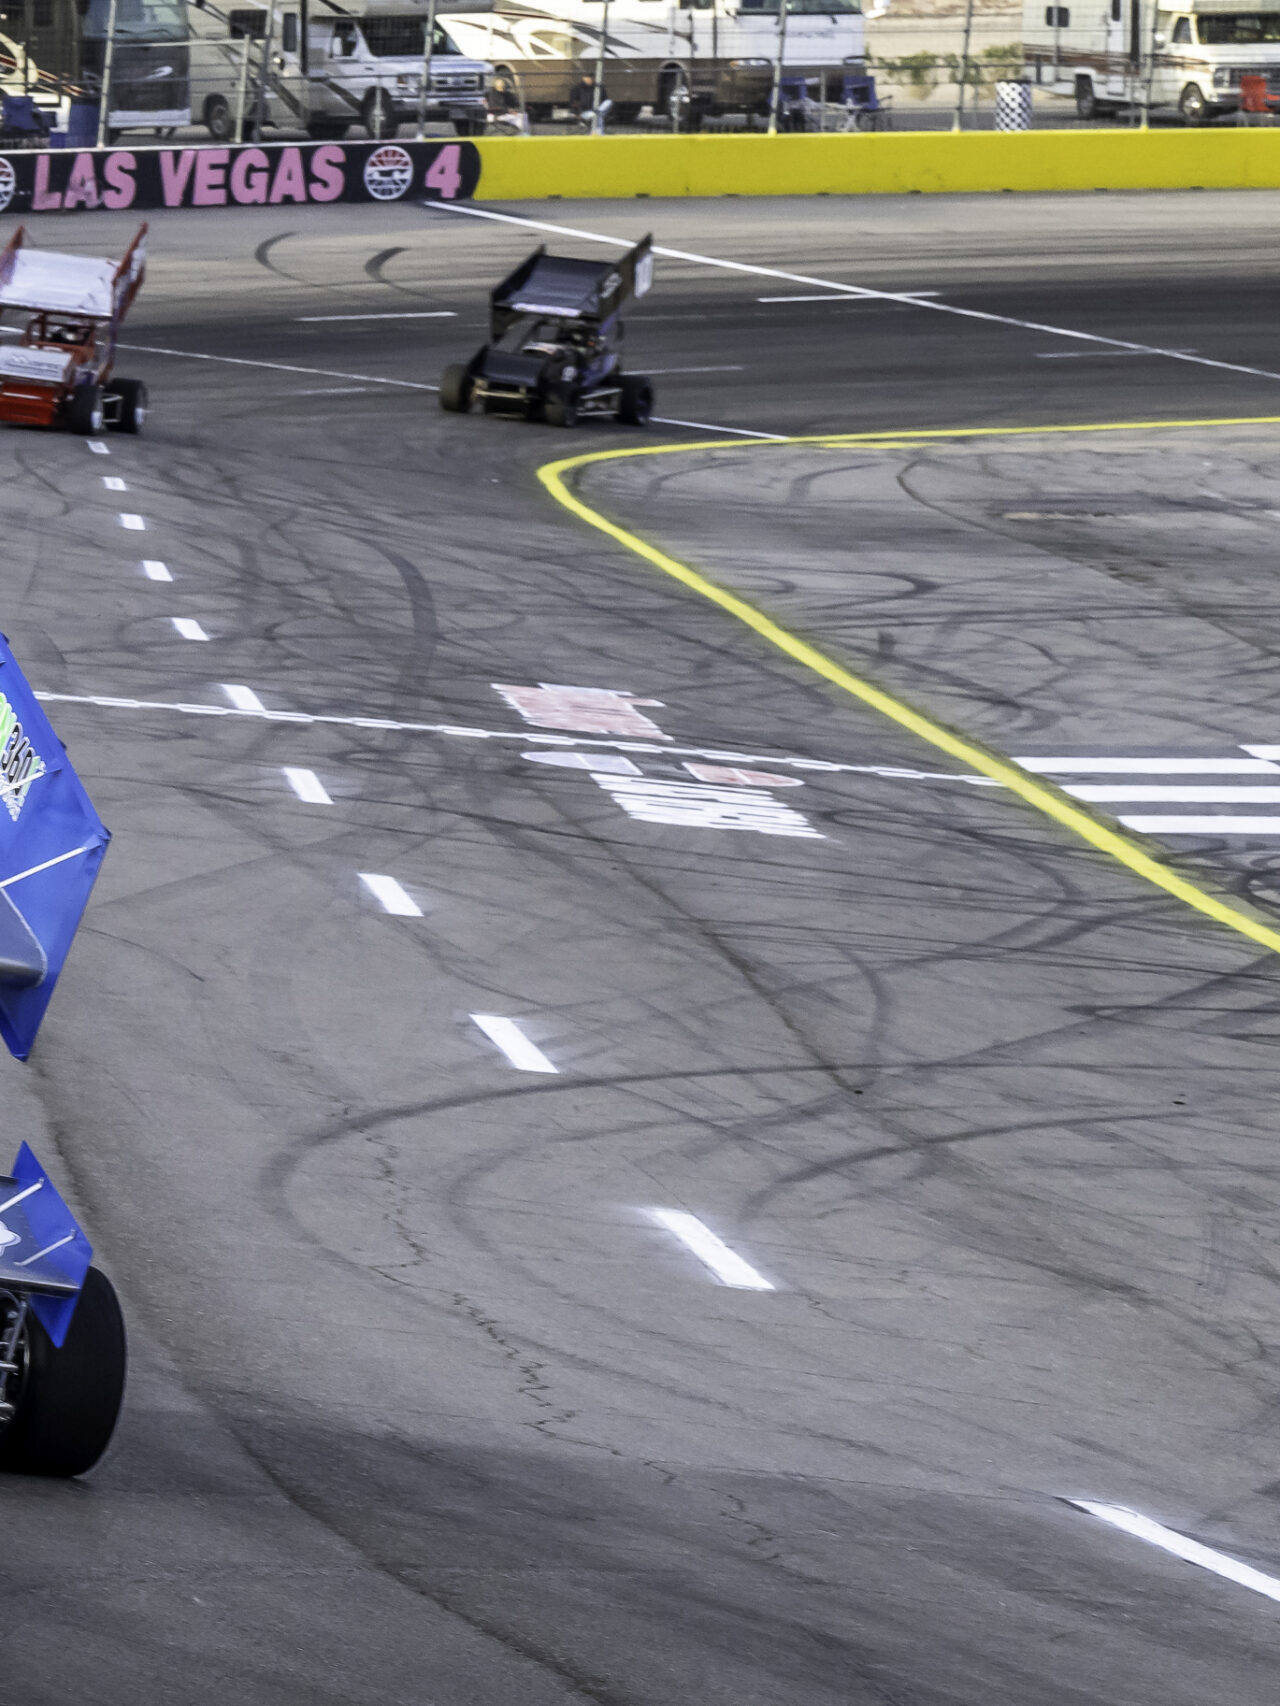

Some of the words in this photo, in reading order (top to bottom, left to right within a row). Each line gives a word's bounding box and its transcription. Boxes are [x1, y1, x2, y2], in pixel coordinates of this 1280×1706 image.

[32, 151, 138, 211] LAS
[159, 144, 347, 207] VEGAS
[424, 144, 462, 199] 4
